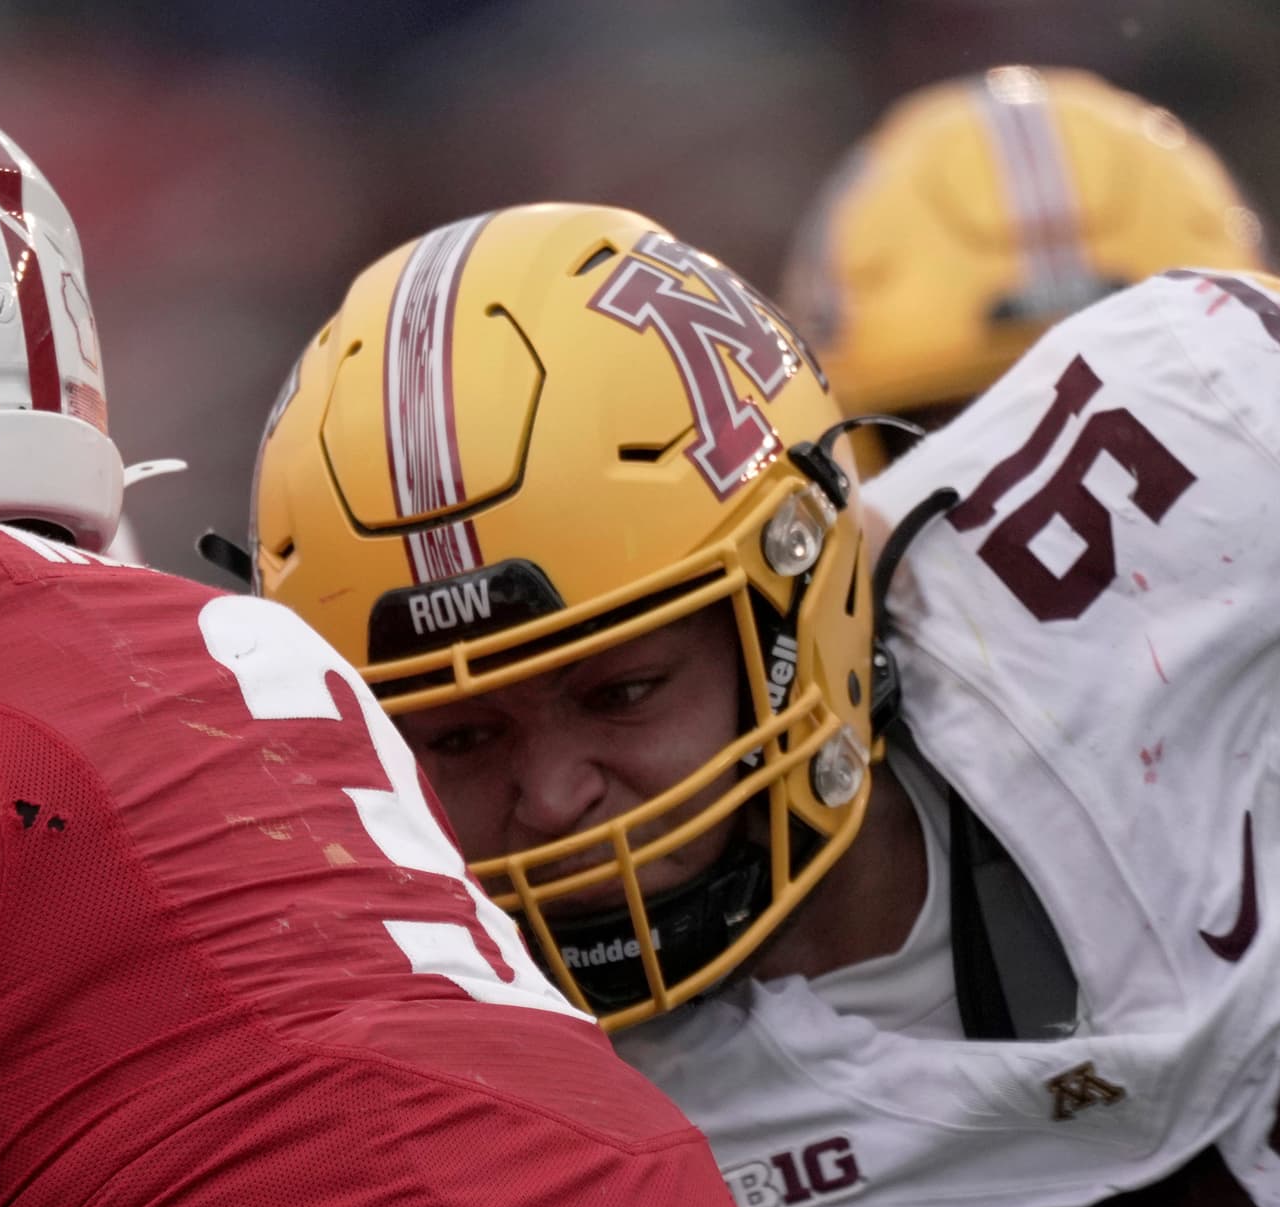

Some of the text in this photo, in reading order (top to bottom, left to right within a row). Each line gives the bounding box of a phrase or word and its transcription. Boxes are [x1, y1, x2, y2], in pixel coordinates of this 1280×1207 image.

[587, 231, 800, 502] M
[408, 578, 492, 635] ROW
[562, 928, 662, 968] Riddel
[1044, 1059, 1127, 1122] M
